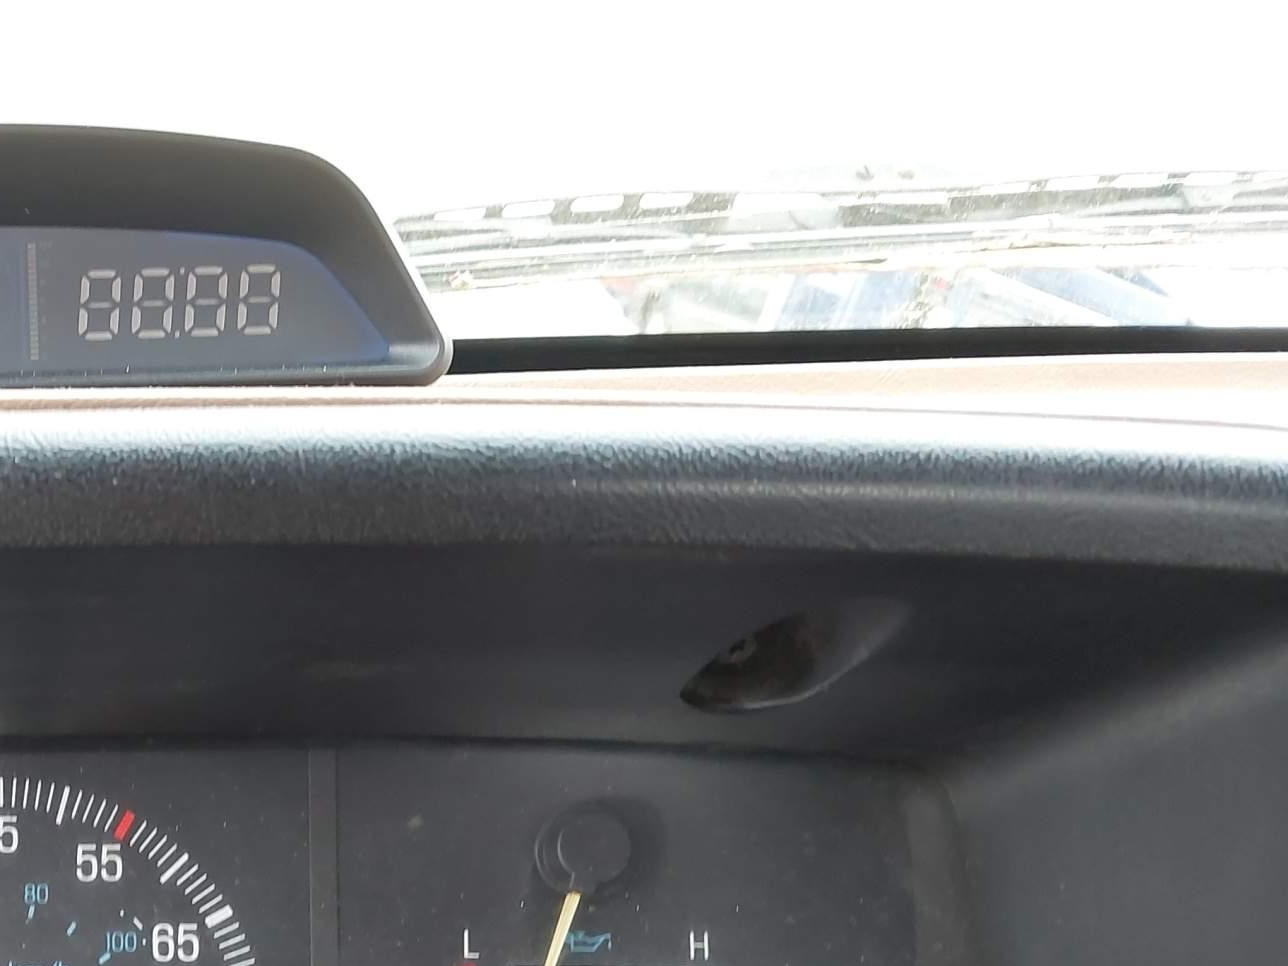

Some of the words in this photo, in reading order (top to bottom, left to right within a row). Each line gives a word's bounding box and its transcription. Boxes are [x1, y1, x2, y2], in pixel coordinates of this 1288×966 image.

[75, 843, 123, 882] 55
[23, 884, 49, 904] 80
[104, 931, 137, 953] 100
[151, 922, 200, 962] 65
[463, 928, 480, 960] L
[688, 930, 710, 961] H
